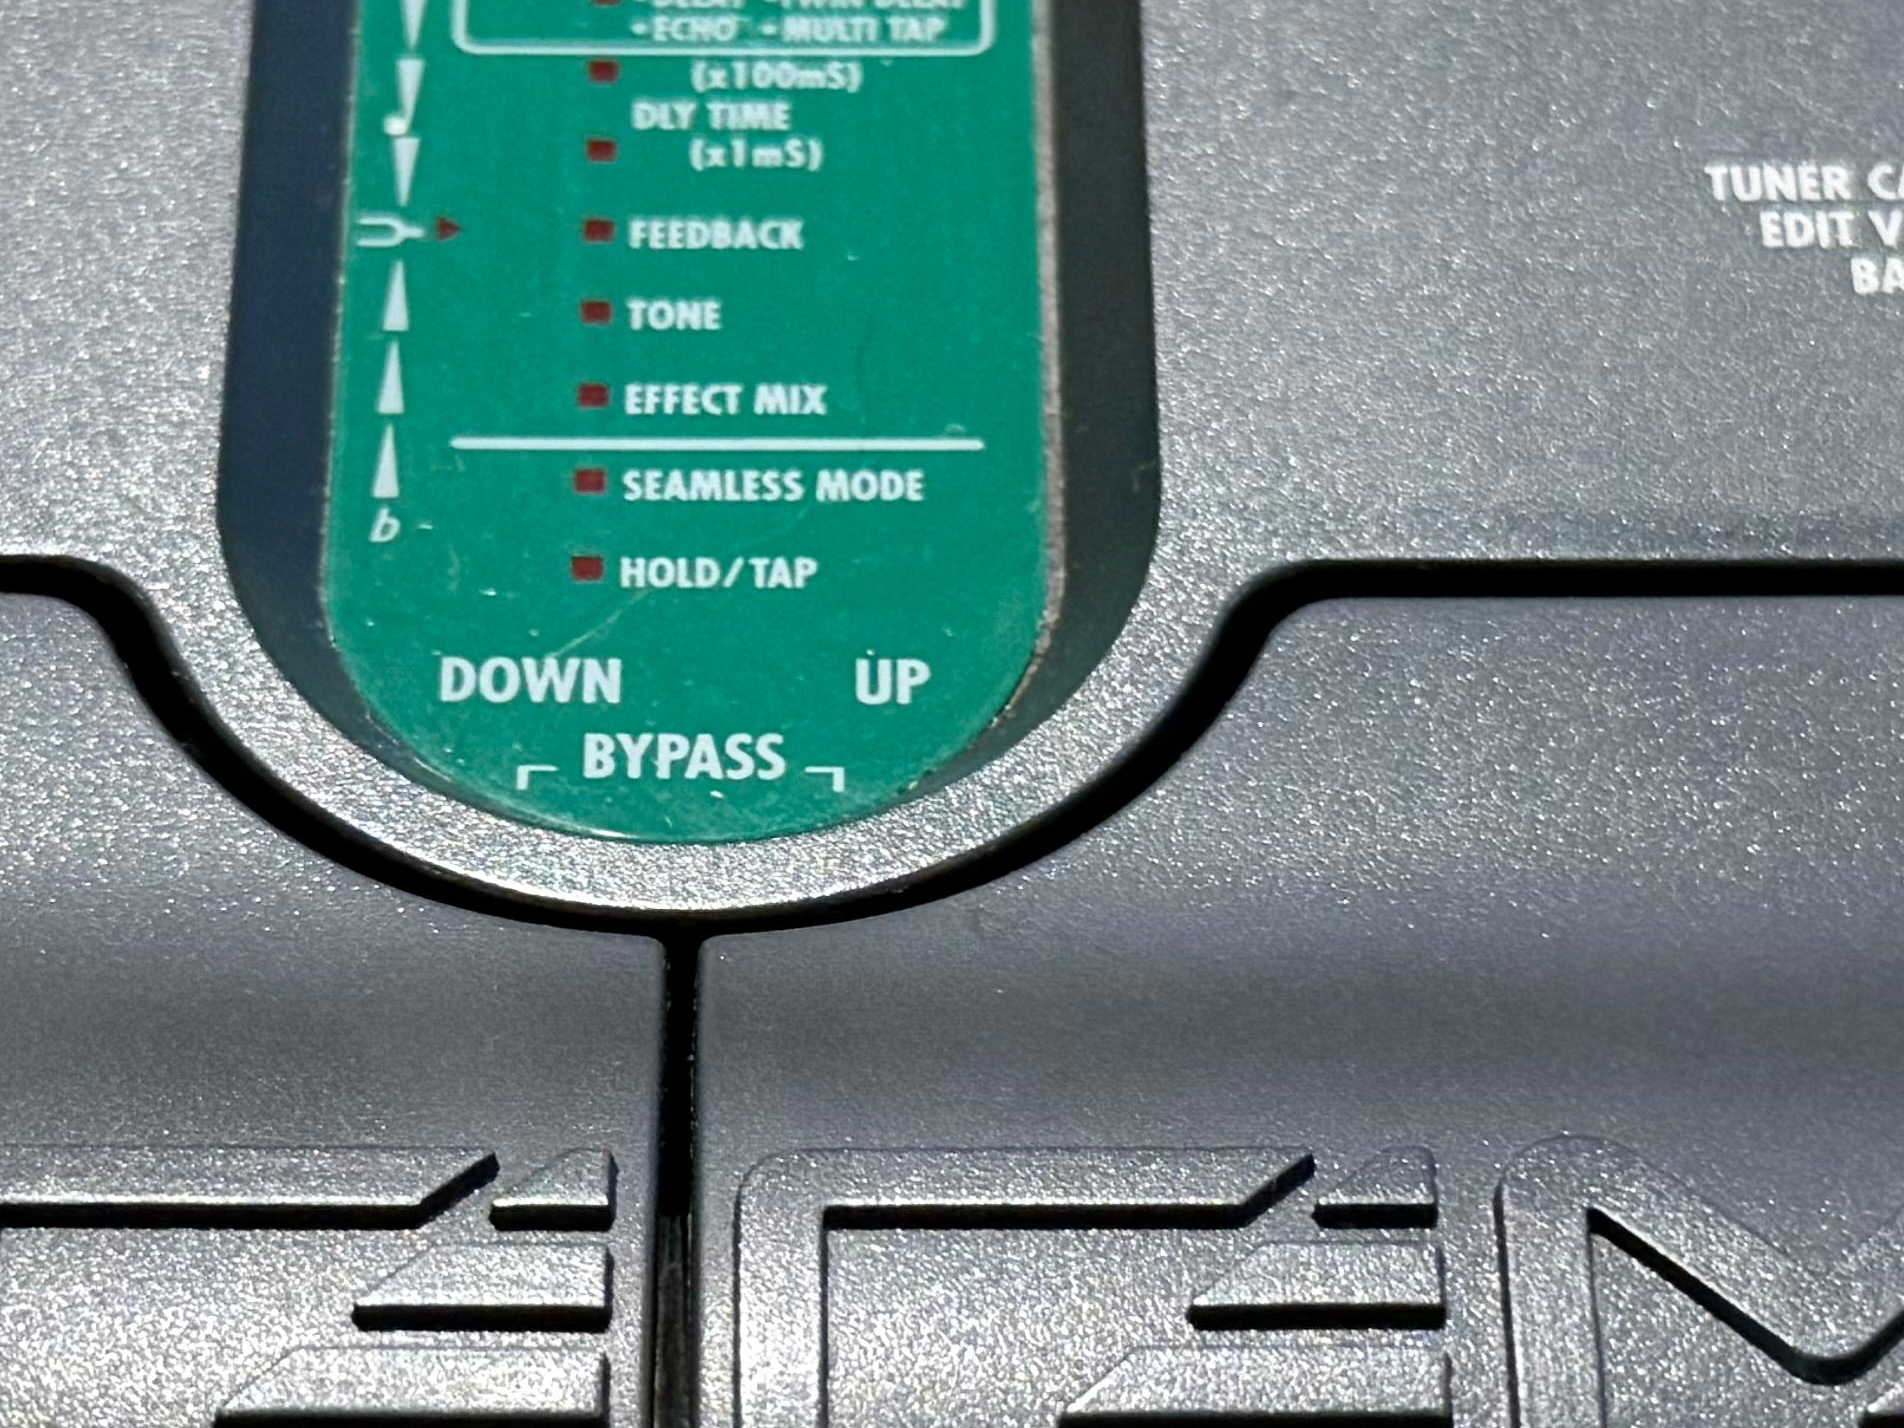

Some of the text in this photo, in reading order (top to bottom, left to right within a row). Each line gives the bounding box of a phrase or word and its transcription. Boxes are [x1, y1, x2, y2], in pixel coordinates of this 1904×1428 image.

[886, 17, 948, 42] TAP
[691, 60, 863, 92] (x100mS)
[632, 101, 791, 130] DLY TIME
[1704, 163, 1852, 202] TUNER
[627, 219, 804, 251] FEEDBACK
[1759, 210, 1854, 249] EDIT
[626, 299, 722, 330] TONE
[624, 383, 827, 415] EFFECT MIX
[622, 469, 925, 501] SEAMLESS MODE
[439, 656, 621, 704] DOWN
[855, 658, 931, 705] UP
[582, 732, 787, 780] BYPASS
